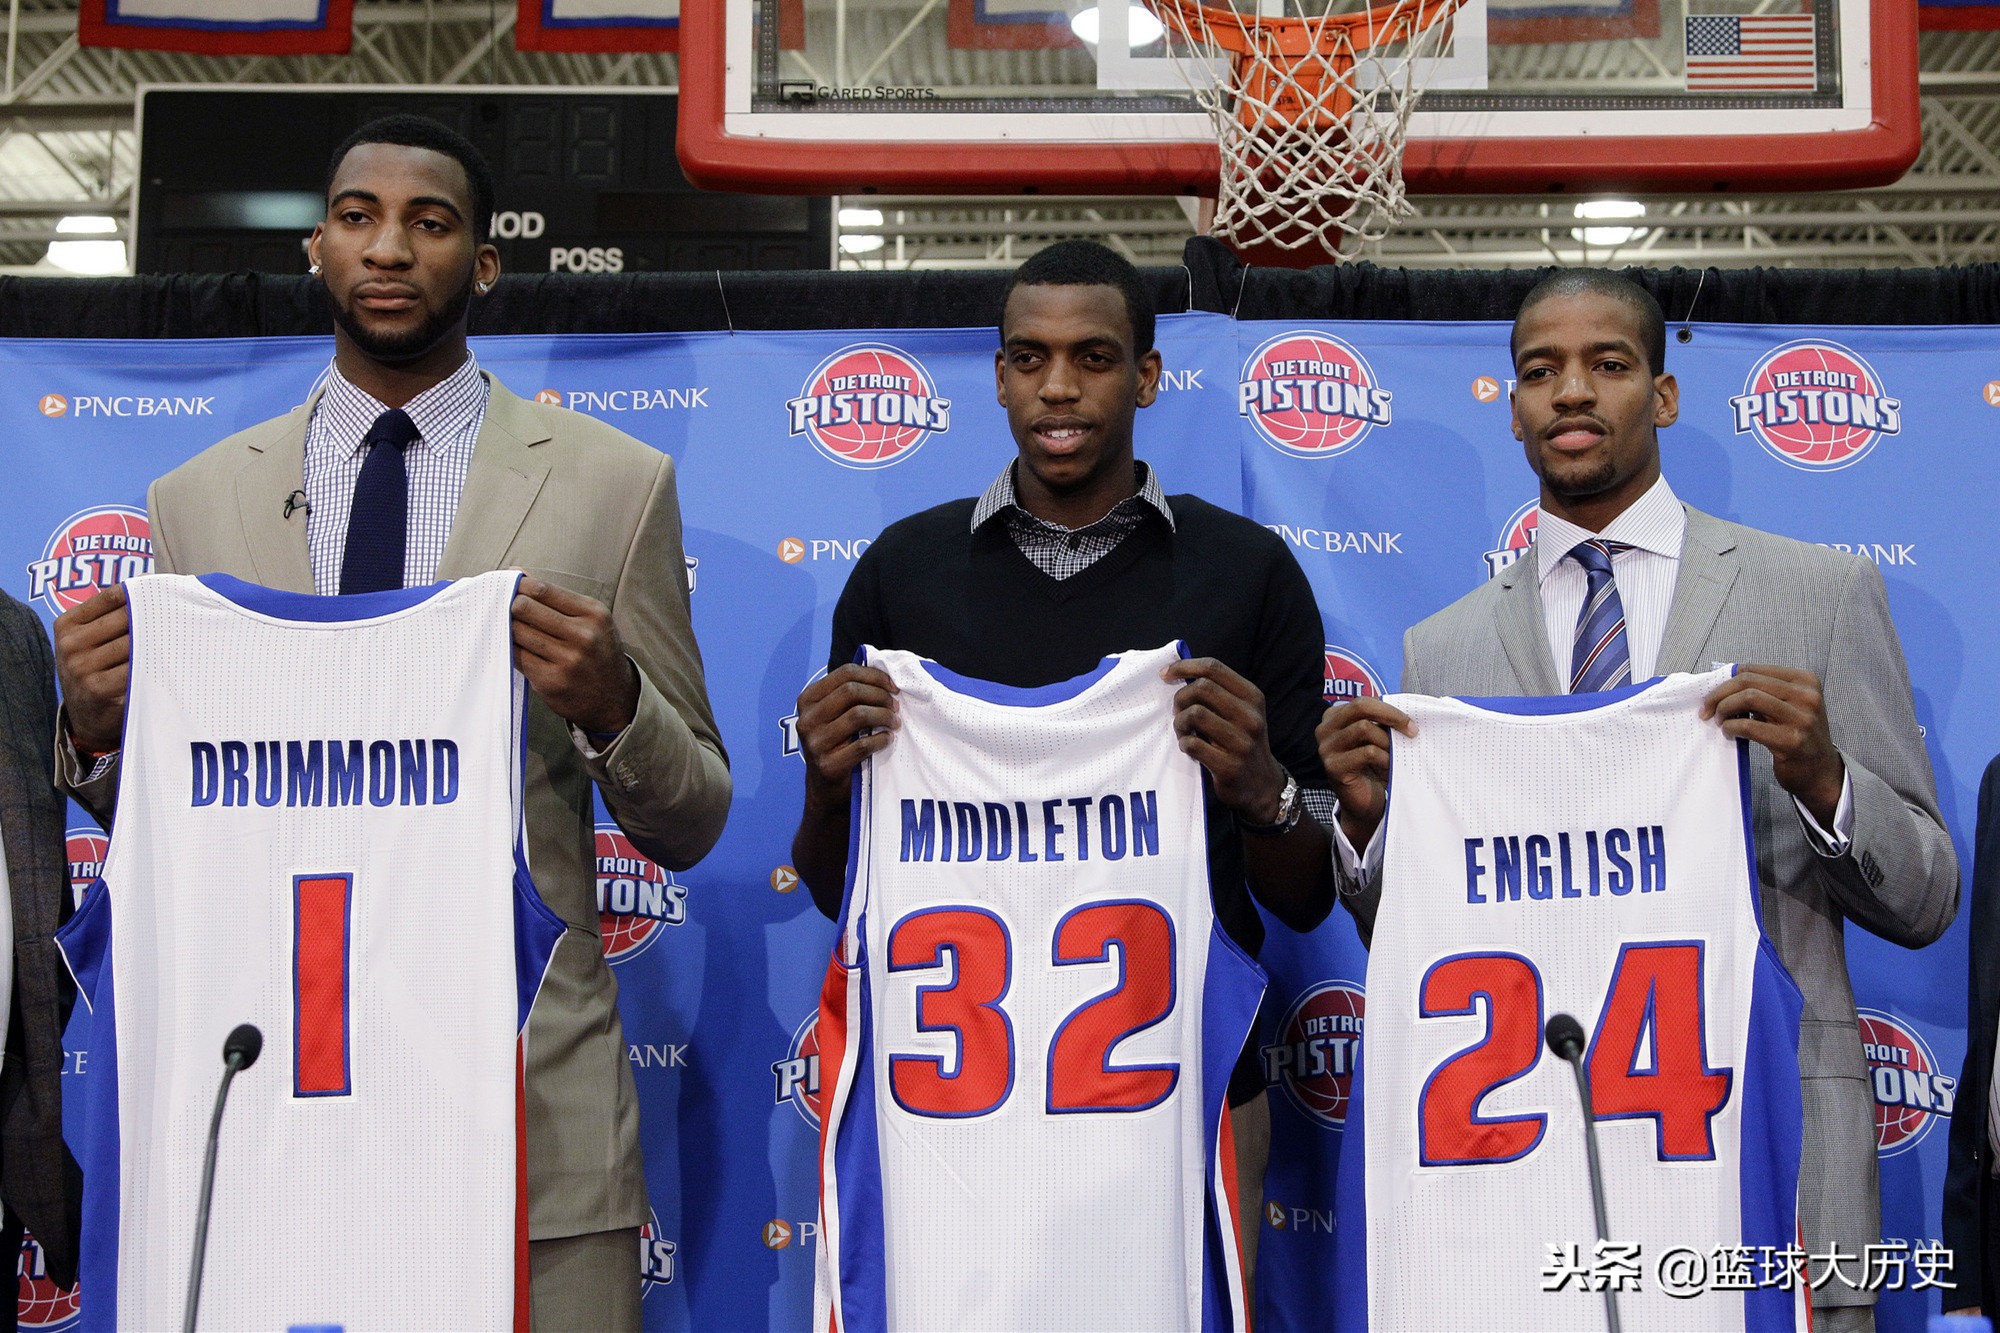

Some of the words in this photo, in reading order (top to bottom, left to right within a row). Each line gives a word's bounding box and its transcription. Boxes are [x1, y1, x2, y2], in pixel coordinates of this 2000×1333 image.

[875, 86, 934, 100] SPORTS
[550, 247, 624, 273] POSS
[831, 374, 912, 392] DETROIT
[1270, 359, 1352, 380] DETROIT
[1773, 371, 1858, 390] DETROIT
[786, 393, 951, 436] PISTONS
[1239, 378, 1393, 425] PISTONS
[1729, 390, 1901, 435] PISTONS
[27, 554, 155, 600] PISTO
[1323, 678, 1364, 697] ROIT
[190, 738, 459, 807] DRUMMOND
[899, 790, 1160, 863] MIDDLETON
[1464, 825, 1666, 904] ENGLISH
[291, 871, 354, 1100] 1
[886, 898, 1181, 1119] 32
[1418, 939, 1733, 1167] 24
